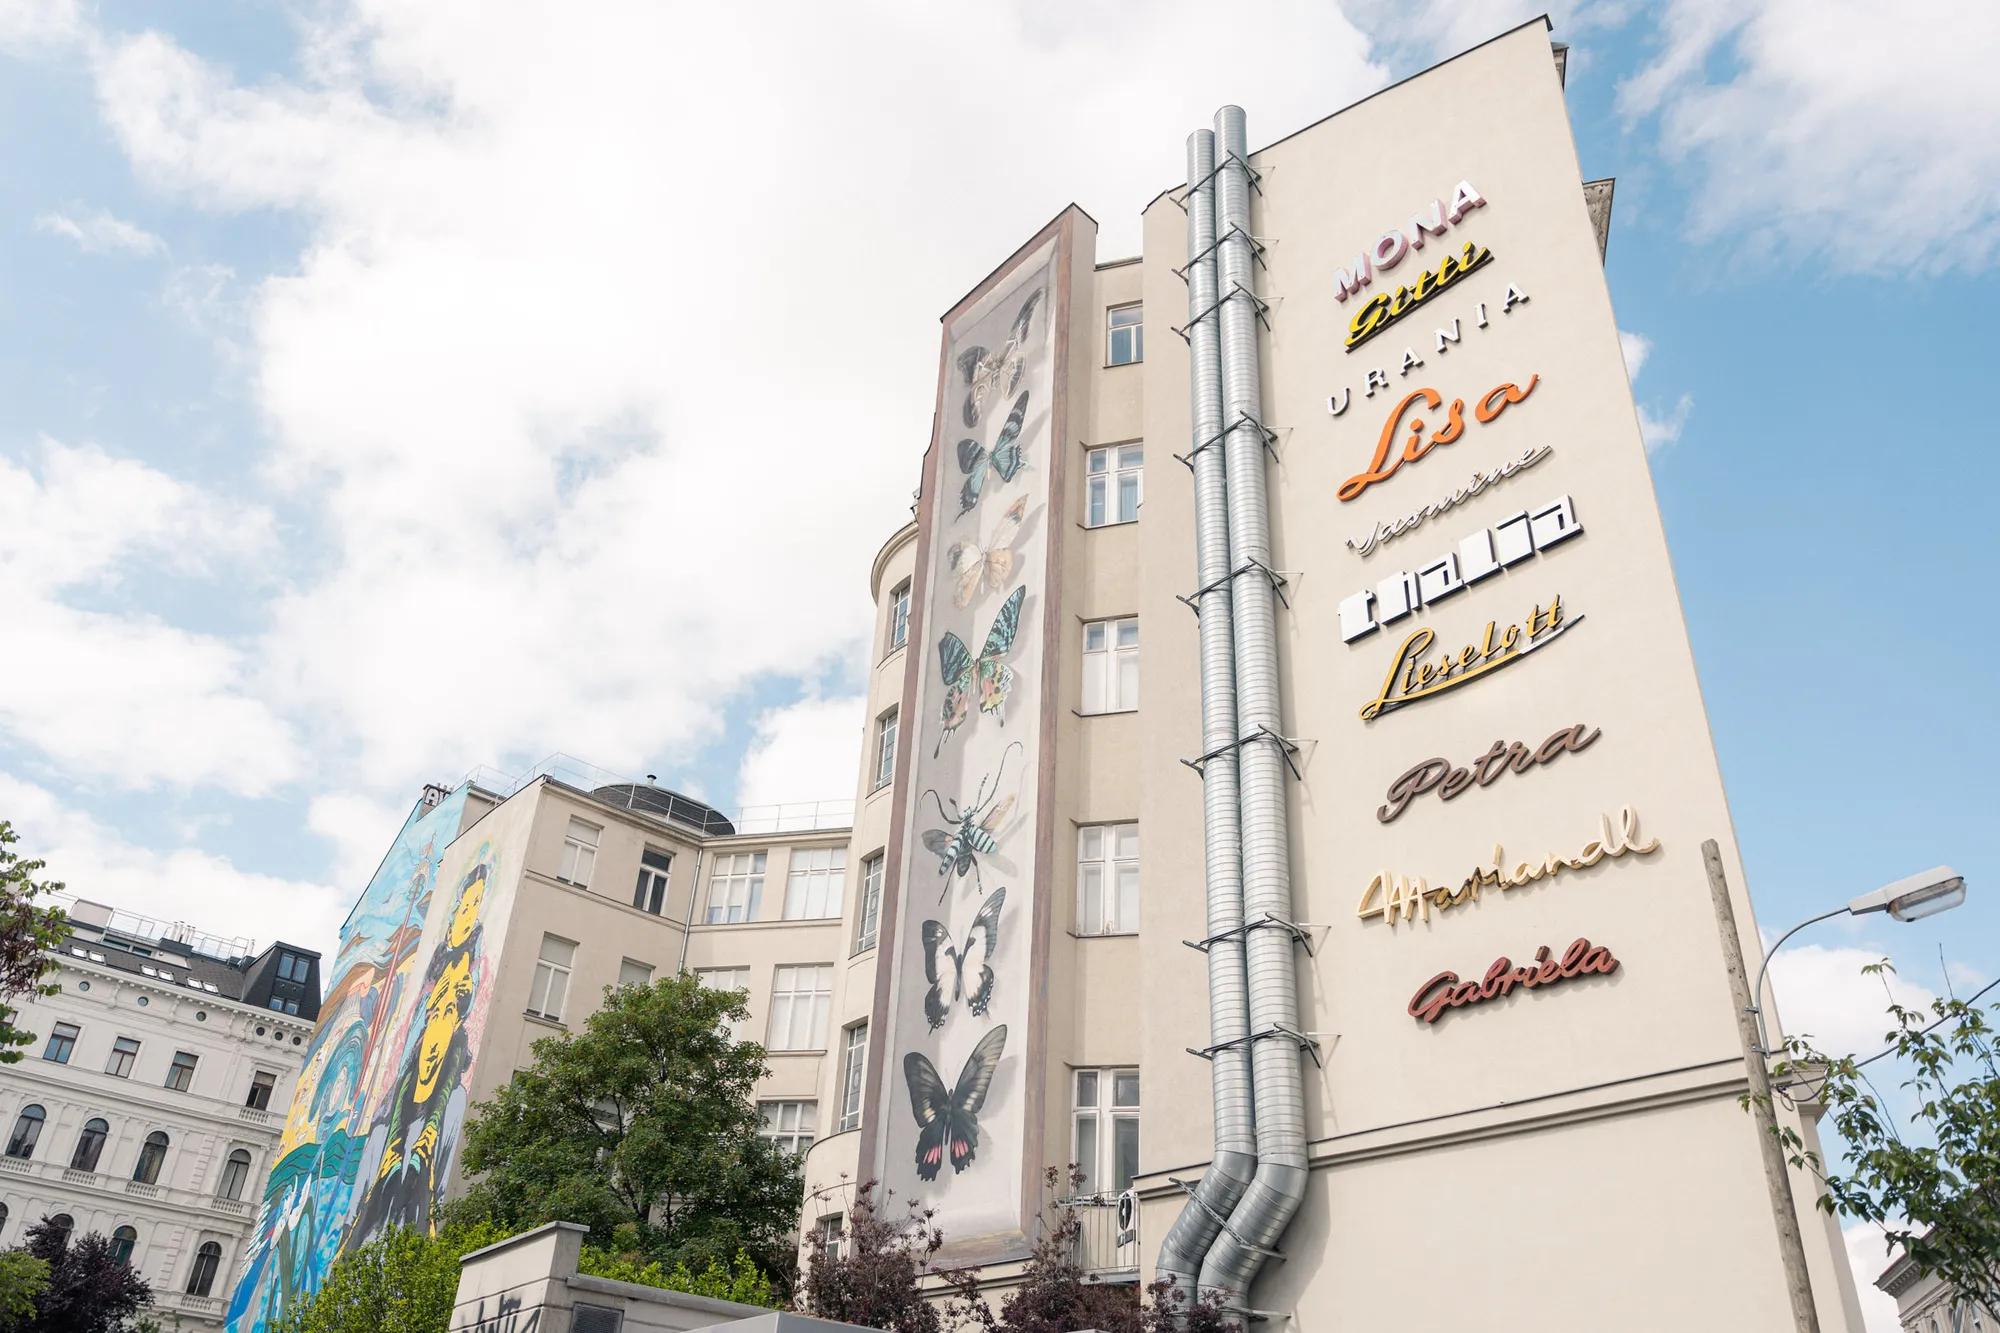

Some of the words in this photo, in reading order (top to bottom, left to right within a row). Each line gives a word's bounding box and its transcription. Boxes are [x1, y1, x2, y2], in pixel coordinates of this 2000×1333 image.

[1333, 179, 1487, 302] MONA
[1344, 240, 1494, 353] Gitti
[1328, 281, 1530, 415] URANIA
[1336, 373, 1541, 502] Lisa
[1358, 594, 1585, 721] Lieselott
[1376, 723, 1602, 823] Petra
[1357, 804, 1661, 926] Mariandl
[1407, 937, 1621, 1023] Gabriela
